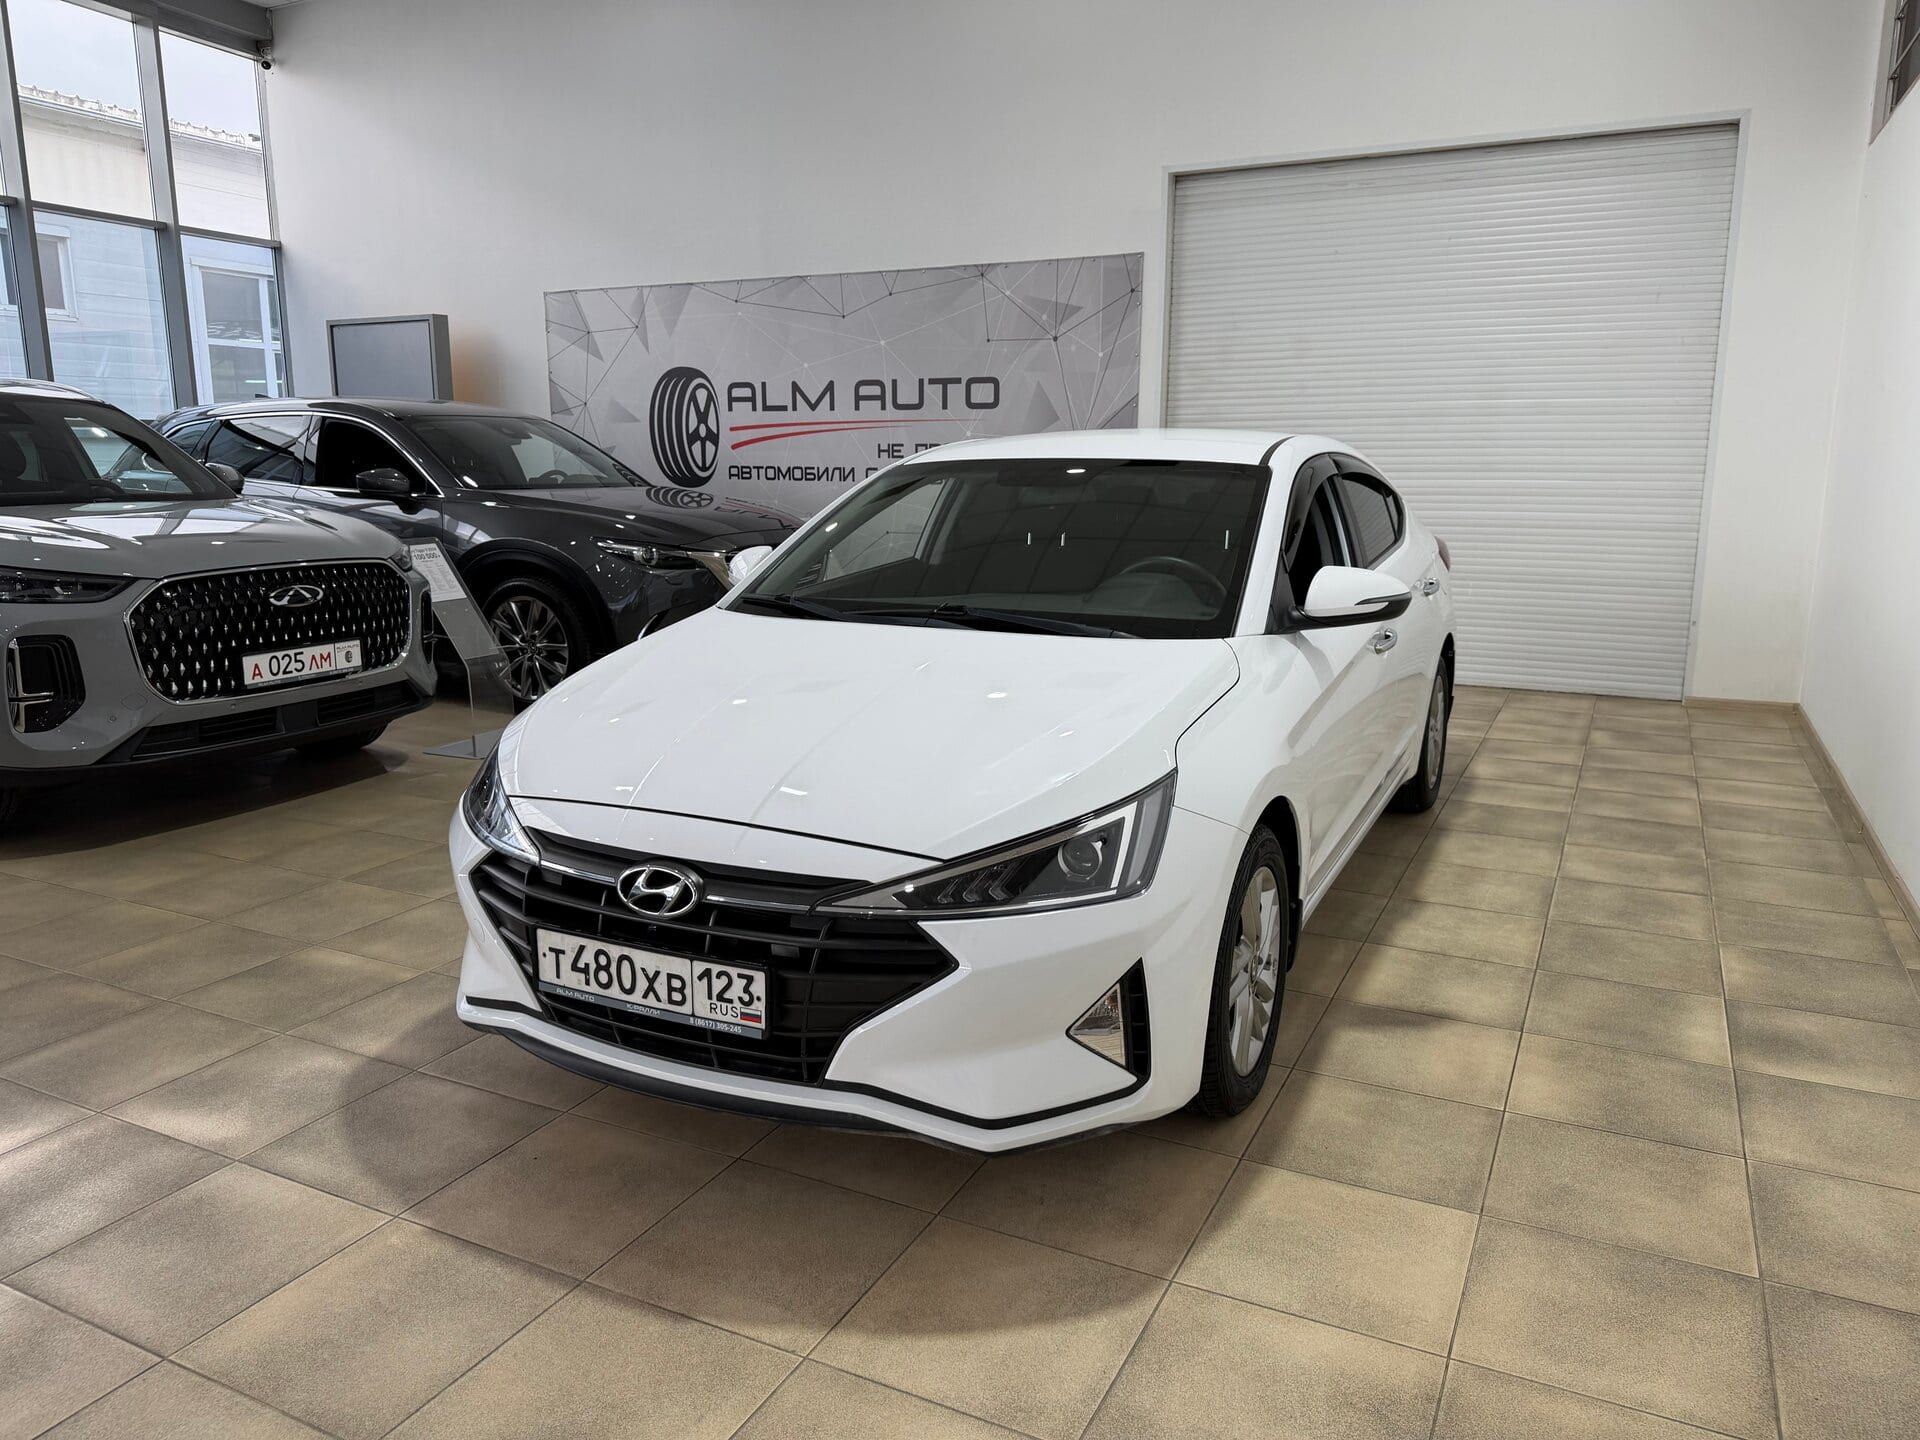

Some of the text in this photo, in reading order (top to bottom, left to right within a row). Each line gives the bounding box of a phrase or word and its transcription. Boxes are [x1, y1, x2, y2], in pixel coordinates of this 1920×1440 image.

[727, 376, 1000, 412] ALM AUTO
[877, 443, 905, 459] НЕ
[728, 465, 856, 482] АВТОМОБИЛИ
[268, 651, 306, 677] 025
[696, 967, 755, 1007] 123
[574, 992, 595, 1002] AUTO
[709, 1002, 739, 1018] RUS
